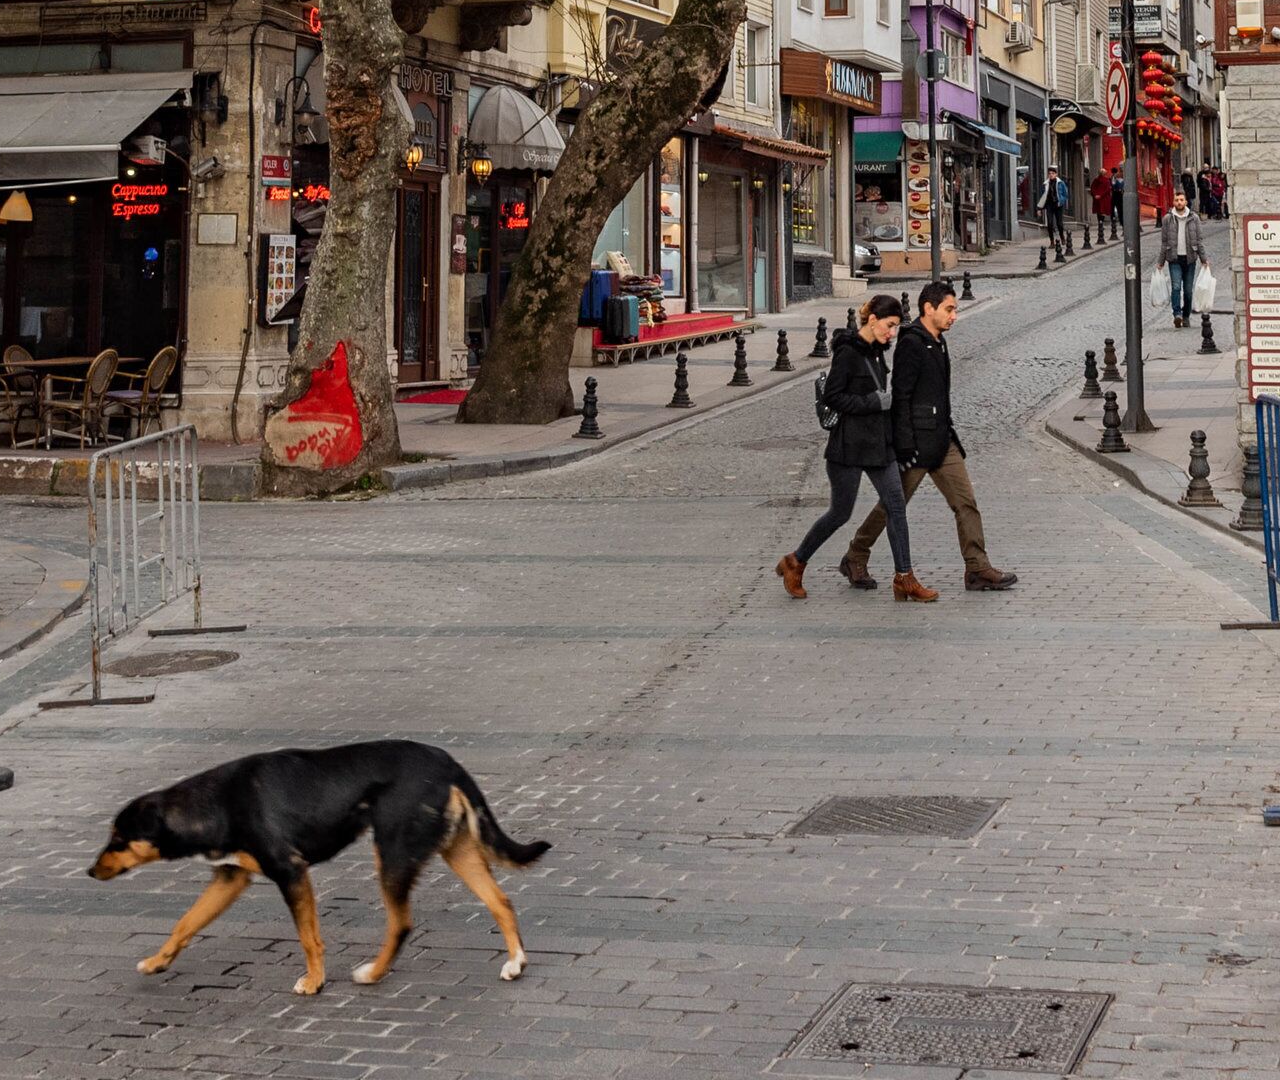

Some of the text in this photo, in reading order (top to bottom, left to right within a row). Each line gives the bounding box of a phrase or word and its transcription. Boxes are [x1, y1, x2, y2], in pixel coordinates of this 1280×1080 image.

[400, 63, 453, 98] HOTEL
[854, 164, 887, 172] AURANT
[111, 203, 160, 220] Espresso
